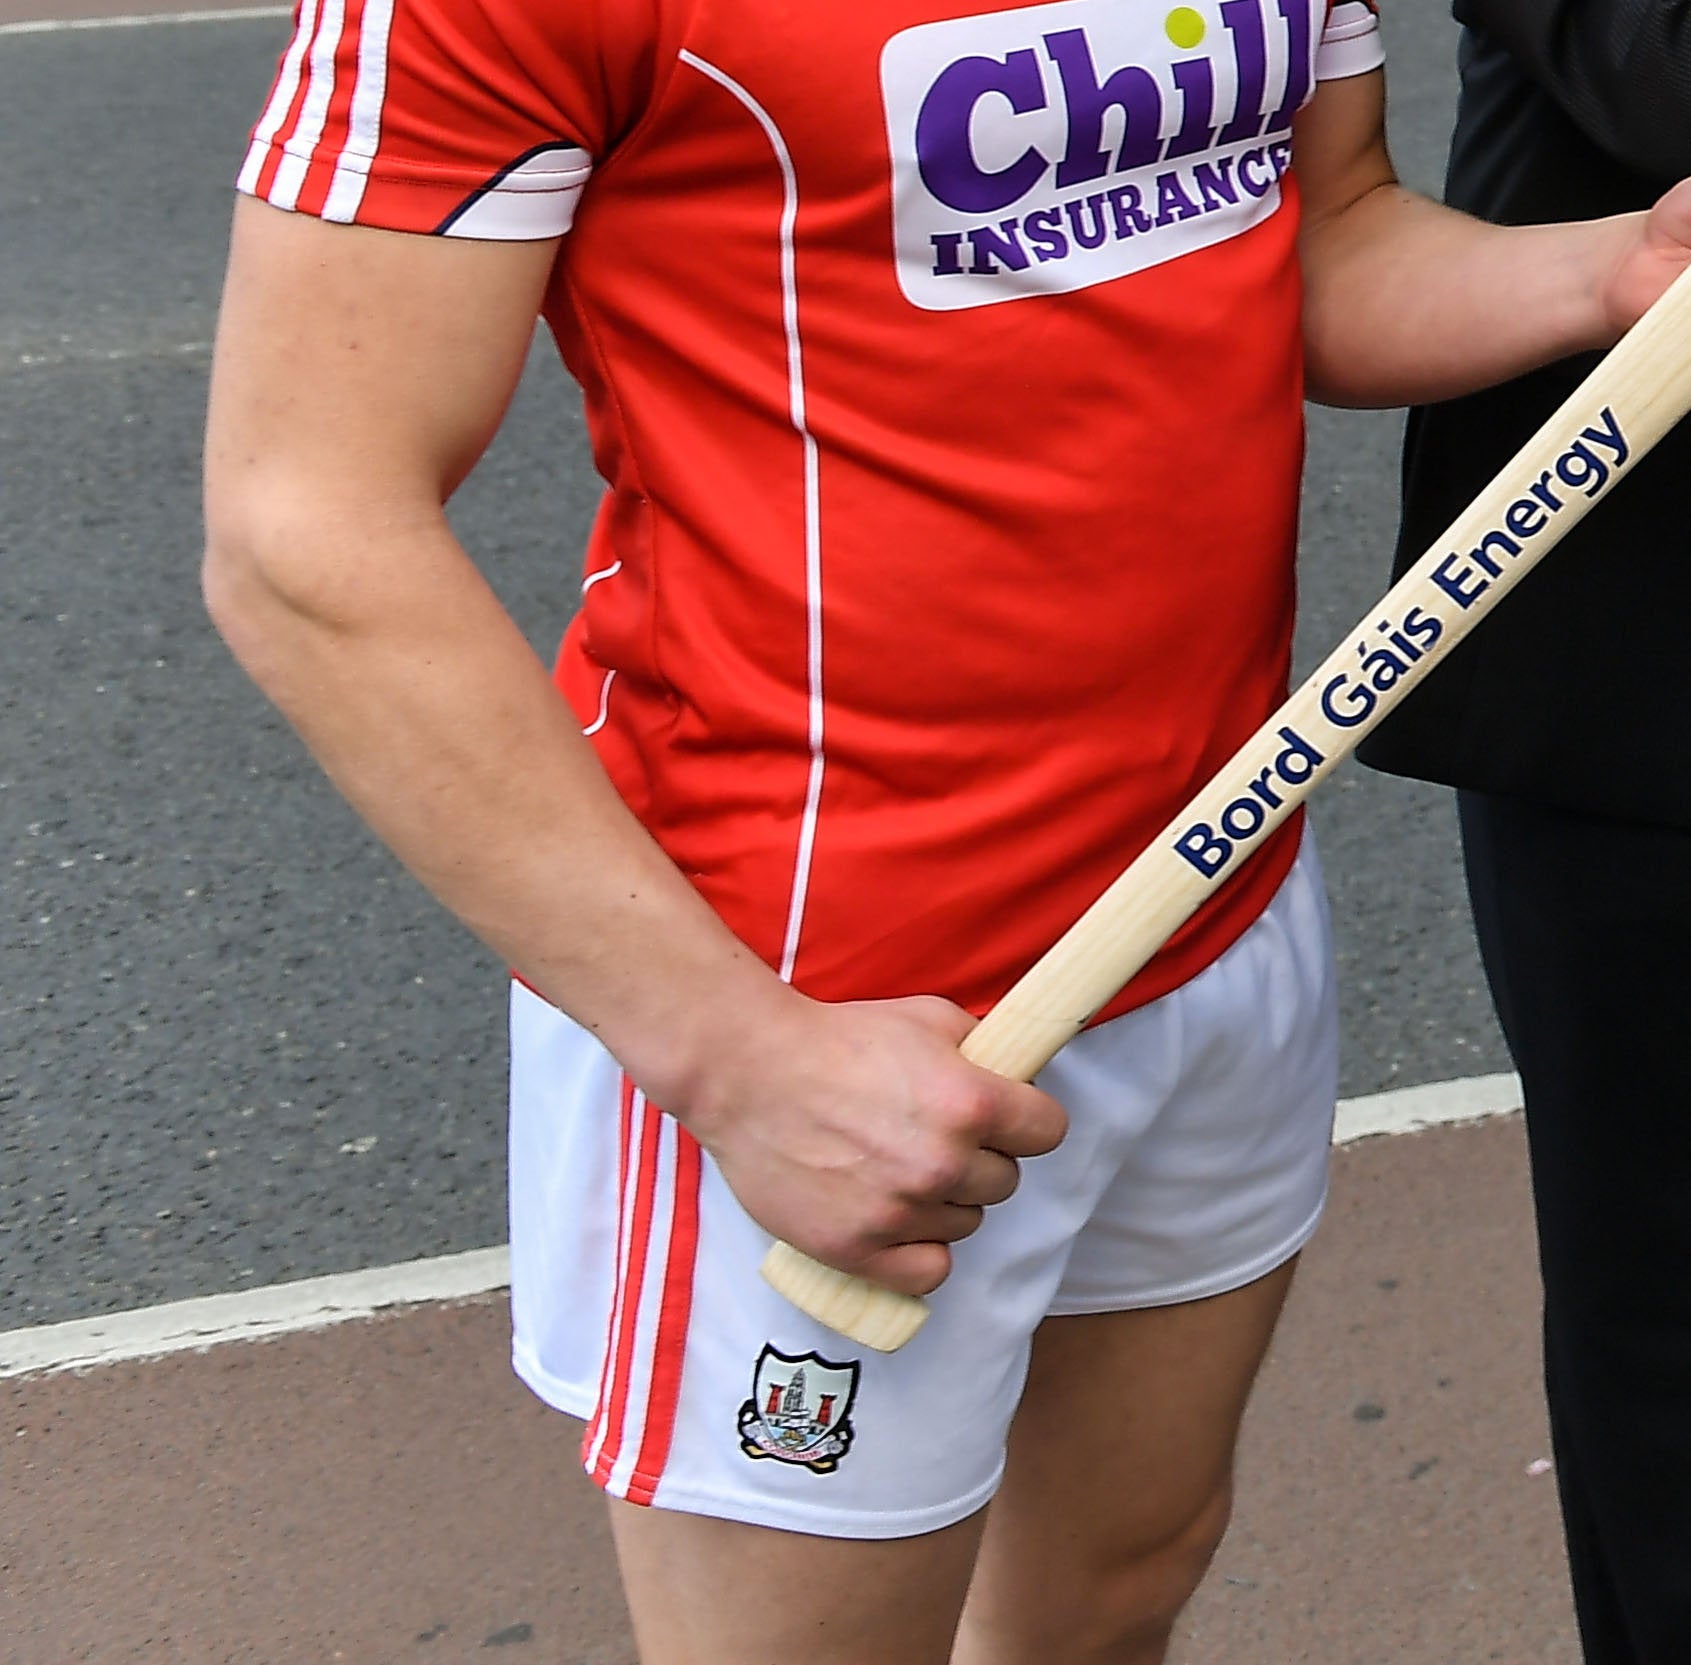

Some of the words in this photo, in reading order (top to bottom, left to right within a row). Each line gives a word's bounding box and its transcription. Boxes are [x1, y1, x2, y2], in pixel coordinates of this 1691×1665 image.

[930, 142, 1293, 278] INSURANCE
[1174, 726, 1326, 880] Bord
[1320, 607, 1444, 728] Gáis
[1430, 405, 1632, 611] Energy
